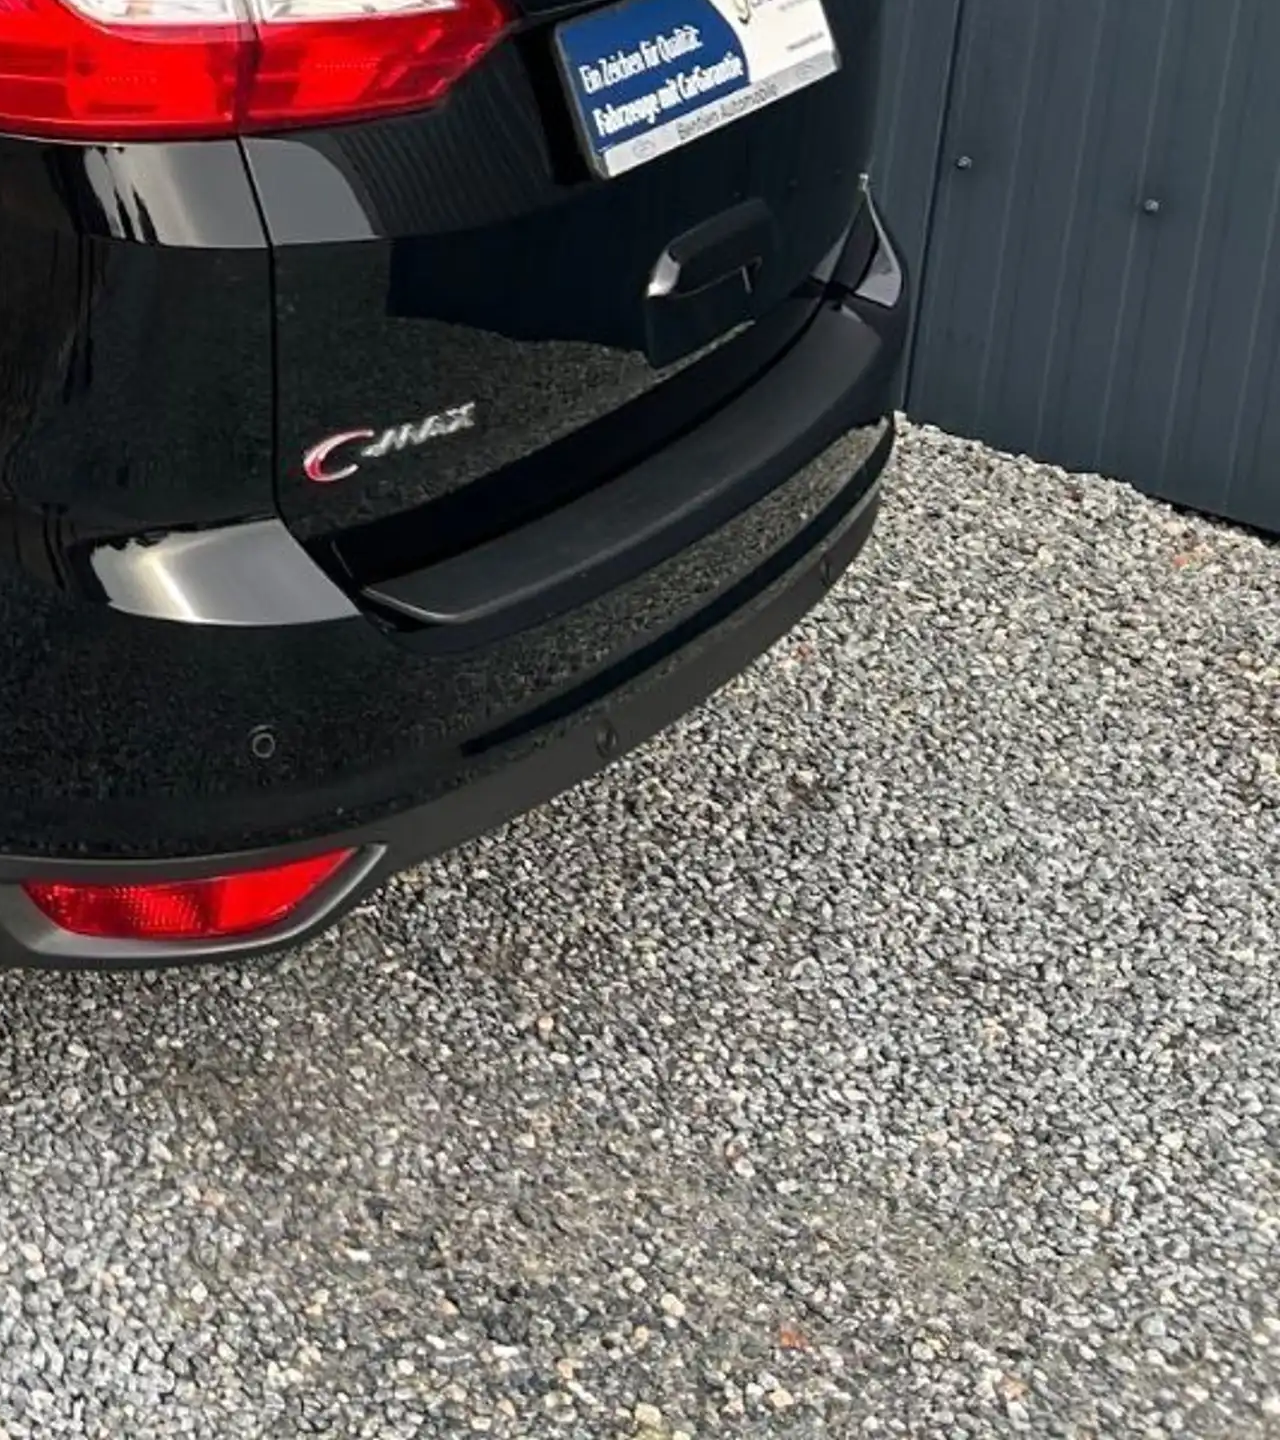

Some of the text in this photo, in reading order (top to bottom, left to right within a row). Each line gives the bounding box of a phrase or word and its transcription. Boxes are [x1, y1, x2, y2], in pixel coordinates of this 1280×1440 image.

[579, 65, 603, 93] Ein
[599, 50, 646, 85] Zeichen
[641, 40, 661, 68] für
[592, 103, 661, 138] Fahrzeuge
[657, 78, 684, 109] mit
